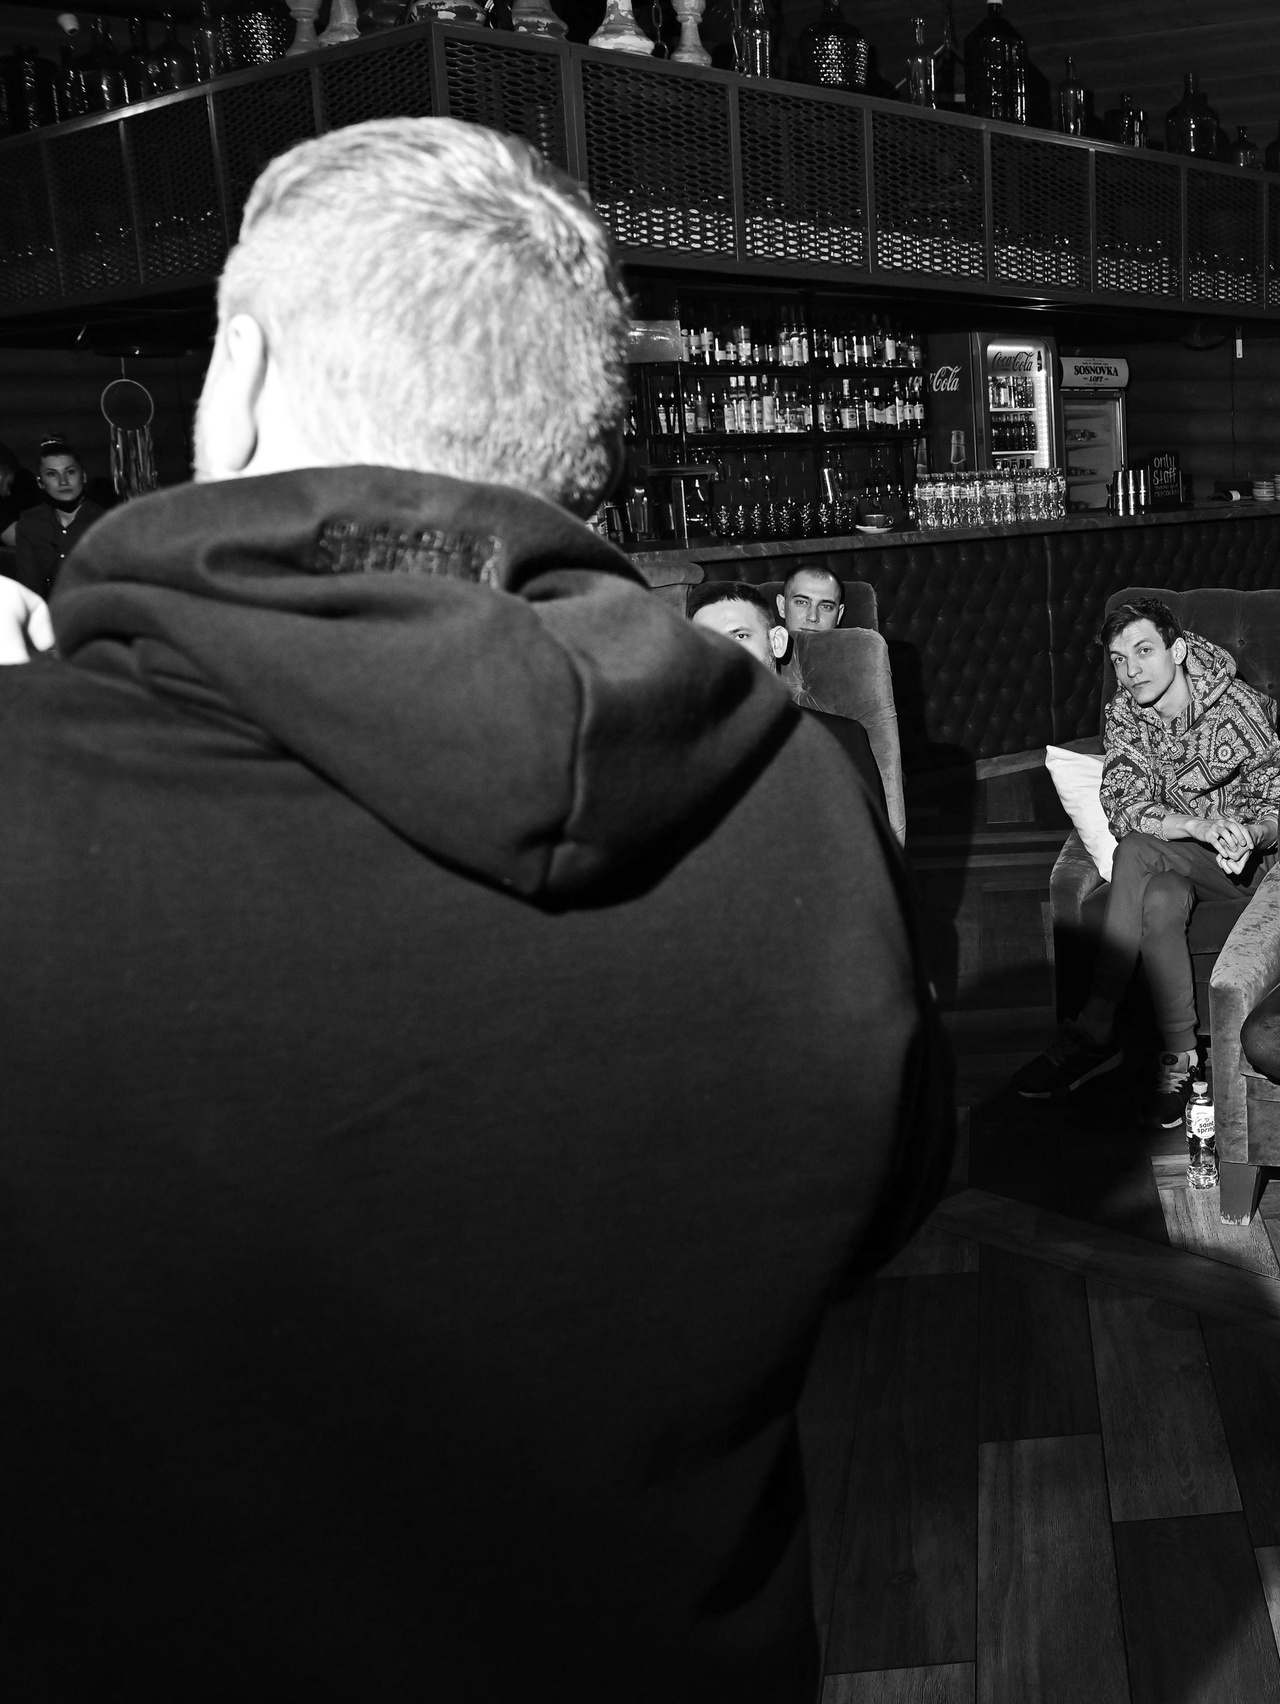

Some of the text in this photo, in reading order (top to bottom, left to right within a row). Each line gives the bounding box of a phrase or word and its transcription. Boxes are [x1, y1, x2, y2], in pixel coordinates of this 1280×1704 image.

[993, 351, 1035, 372] Coca-Cola
[1073, 365, 1119, 377] SOSNOVKA
[1154, 454, 1175, 469] only
